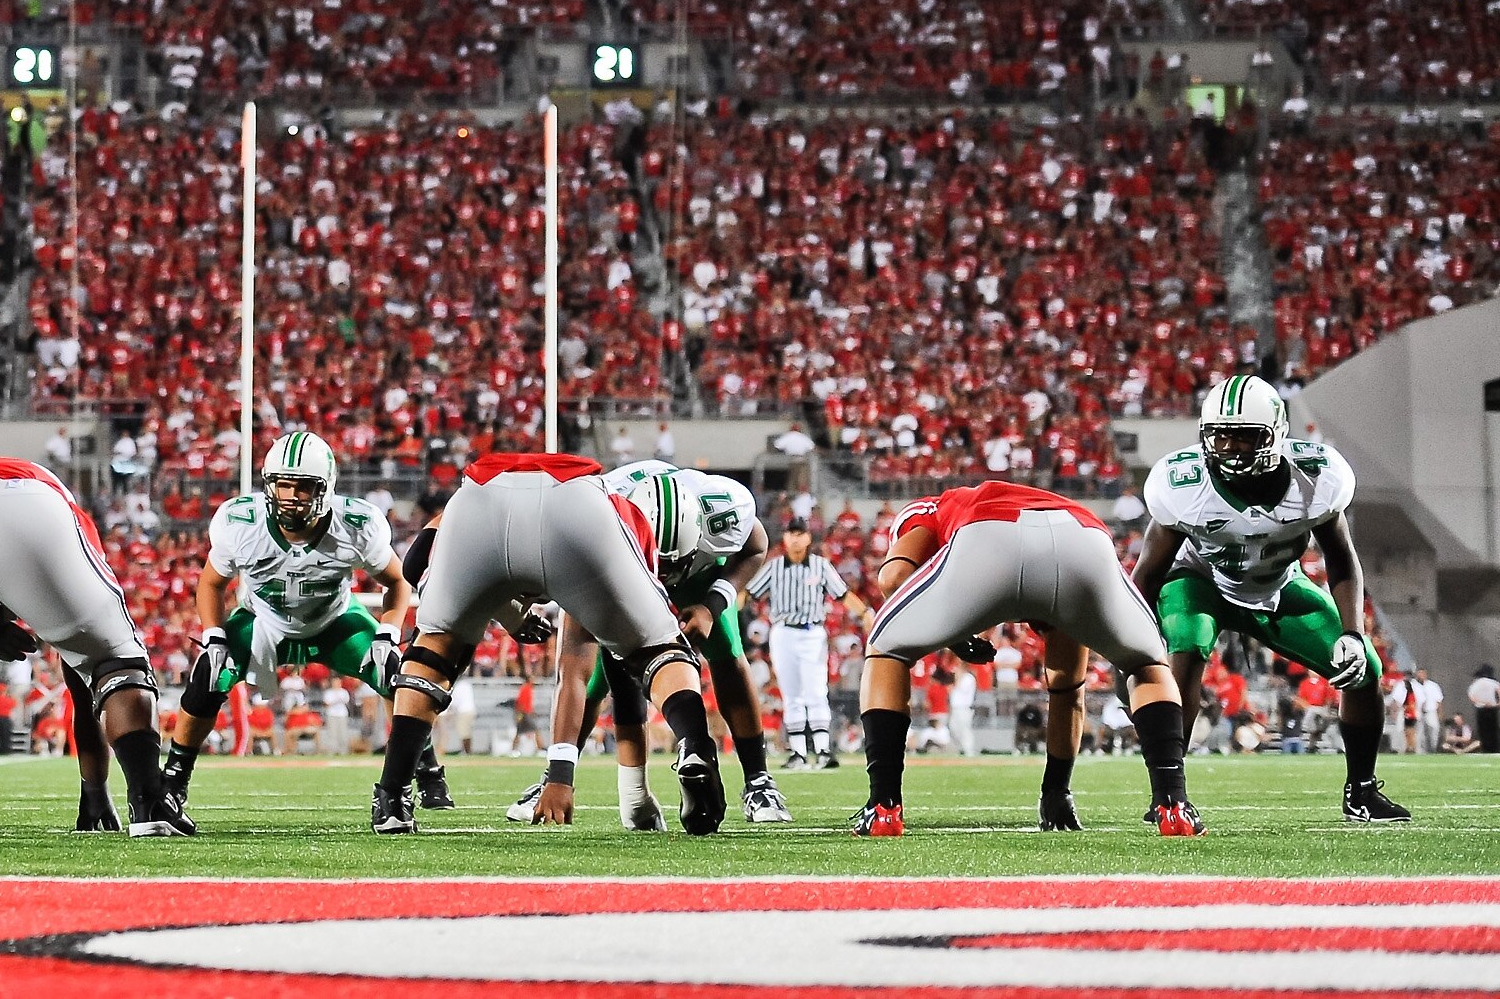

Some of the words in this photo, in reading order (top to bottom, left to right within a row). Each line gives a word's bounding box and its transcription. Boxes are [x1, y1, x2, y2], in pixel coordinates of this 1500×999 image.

[13, 47, 52, 83] 21
[594, 45, 633, 81] 21
[1165, 450, 1204, 490] 43
